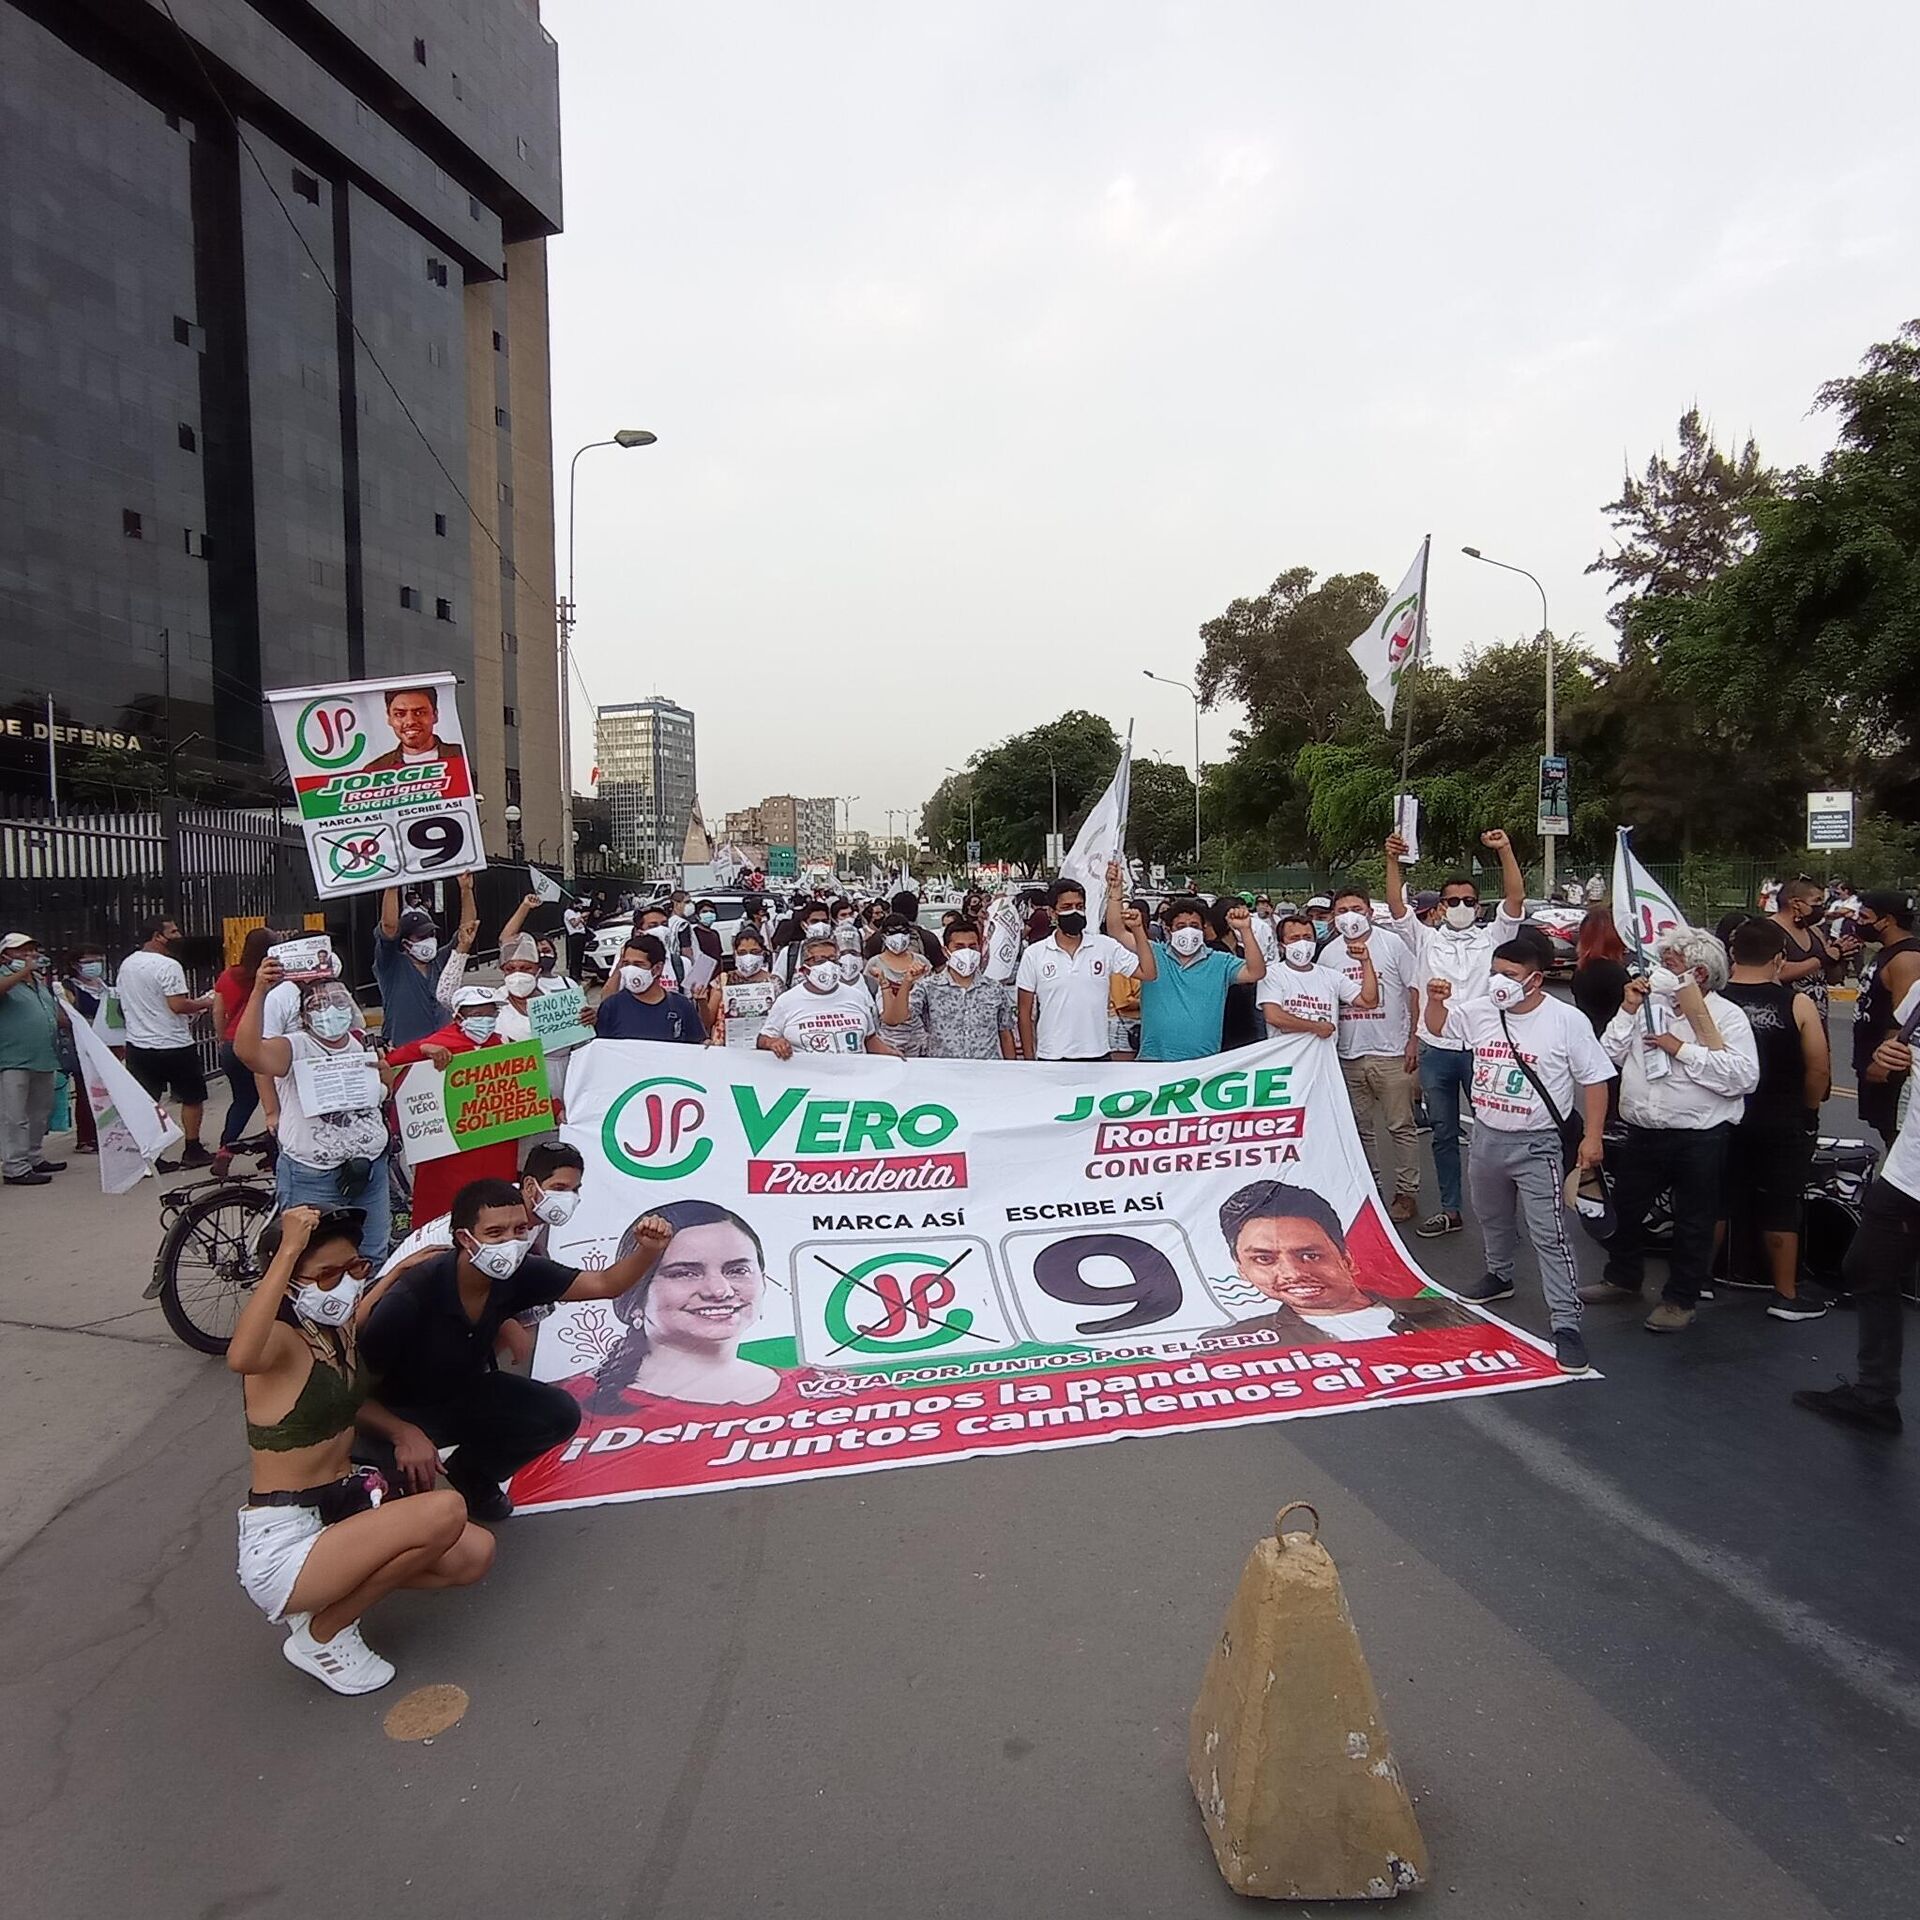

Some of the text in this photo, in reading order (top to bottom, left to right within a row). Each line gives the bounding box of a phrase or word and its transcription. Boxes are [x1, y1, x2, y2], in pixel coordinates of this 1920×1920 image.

[33, 722, 142, 752] DEFENSA
[318, 764, 447, 795] JORGE
[347, 779, 444, 803] Rodríguez
[338, 790, 444, 813] CONGRESISTA
[397, 800, 463, 817] ESCRIBE ASÍ
[319, 812, 383, 829] MARCA ASÍ
[407, 816, 464, 869] 9
[632, 977, 642, 988] 9
[1093, 960, 1103, 975] 9
[532, 998, 558, 1014] #NO
[1496, 989, 1507, 1001] 9
[536, 1007, 578, 1024] TRABAJO
[845, 1031, 859, 1052] 9
[450, 1055, 537, 1089] CHAMBA
[1505, 1069, 1524, 1095] 9
[461, 1086, 538, 1117] MADRES
[475, 1077, 519, 1099] PARA
[1054, 1066, 1293, 1122] JORGE
[455, 1099, 550, 1135] SOLTERAS
[730, 1084, 959, 1157] VERO
[1101, 1114, 1297, 1150] Rodríguez
[763, 1160, 956, 1195] Presidenta
[1084, 1144, 1301, 1180] CONGRESISTA
[812, 1207, 966, 1231] MARCA ASÍ
[1006, 1191, 1165, 1223] ESCRIBE ASÍ
[1033, 1233, 1183, 1334] 9
[799, 1328, 1280, 1394] VOTA POR JUNTOS POR EL PERÚ
[559, 1348, 1362, 1463] ¡Derrotemos la pandemia,
[706, 1348, 1521, 1467] Juntos cambiemos el Perú!
